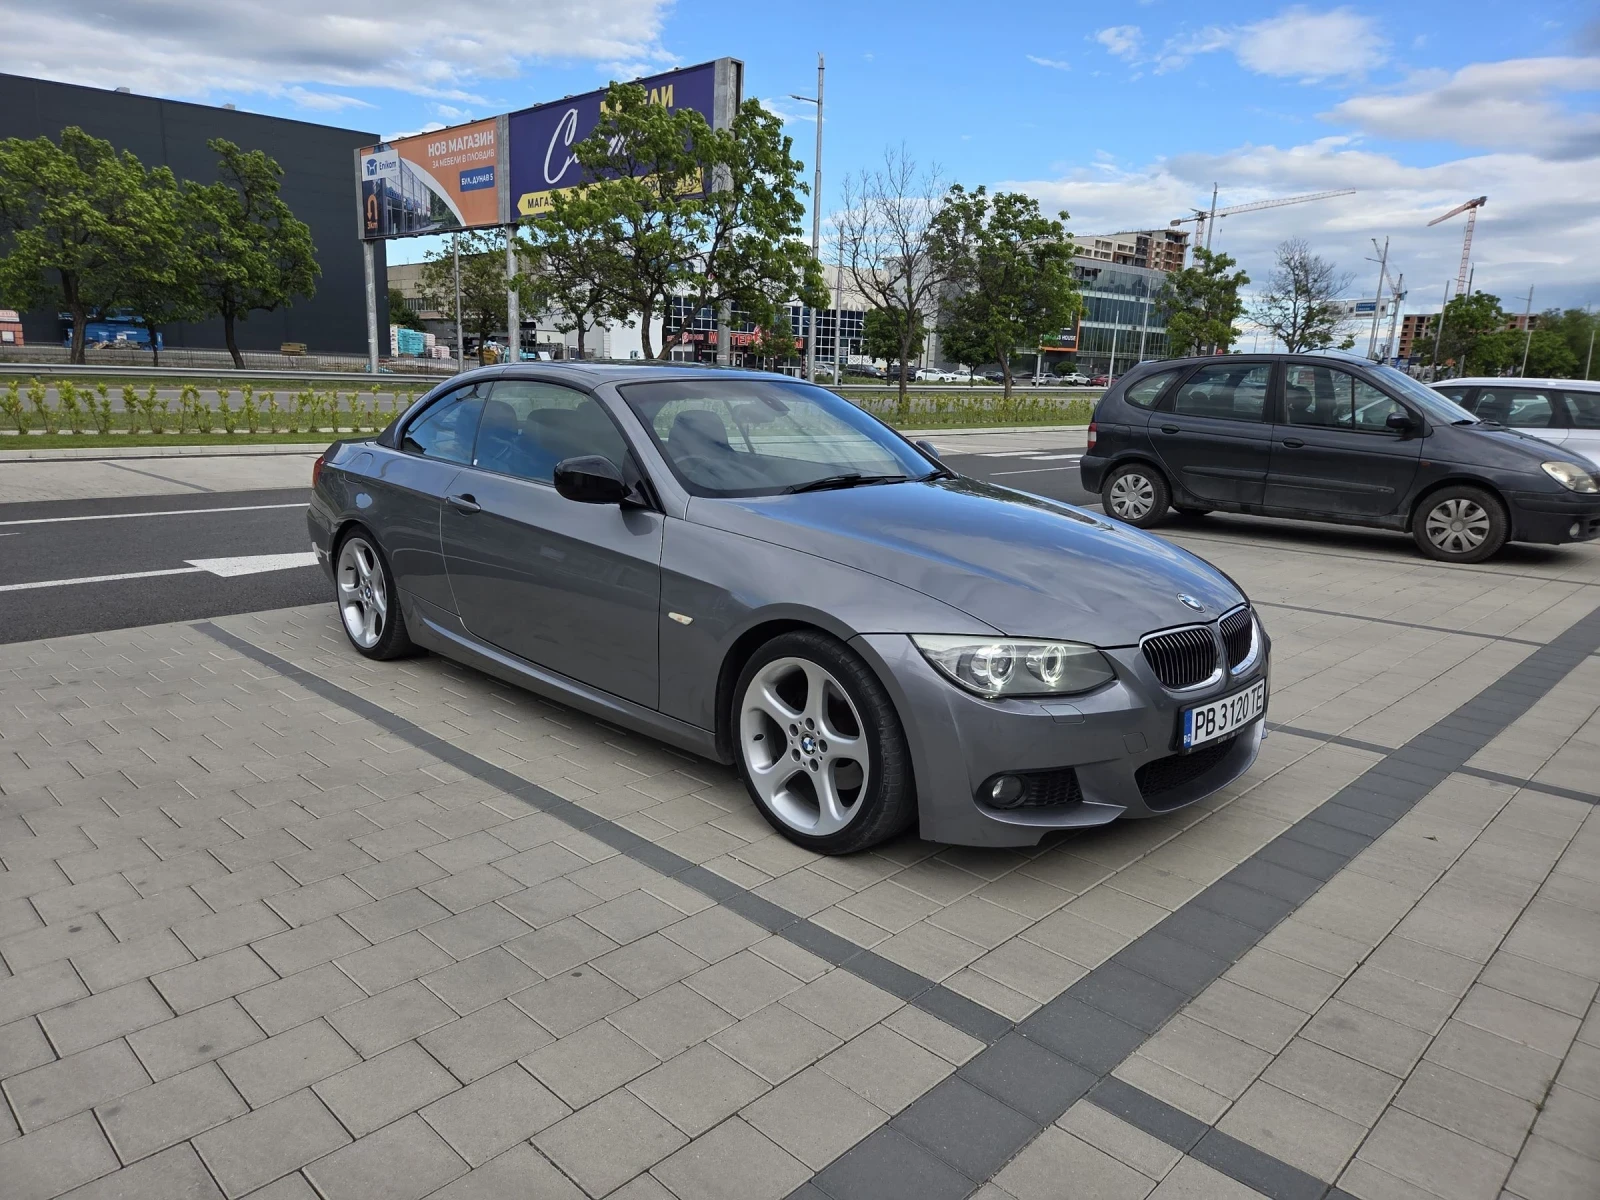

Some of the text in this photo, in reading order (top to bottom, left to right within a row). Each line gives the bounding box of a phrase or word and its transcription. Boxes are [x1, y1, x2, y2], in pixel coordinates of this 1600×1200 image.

[428, 130, 494, 157] НОВ МАГАЗИН
[432, 148, 495, 169] ЗА МЕБЕЛИ В ПЛОВДИВ
[472, 174, 490, 185] ДУНАВ
[490, 173, 494, 181] 5
[1195, 708, 1215, 740] PB
[1219, 693, 1249, 730] 3120
[1252, 684, 1263, 714] TE
[1183, 733, 1192, 744] BG
